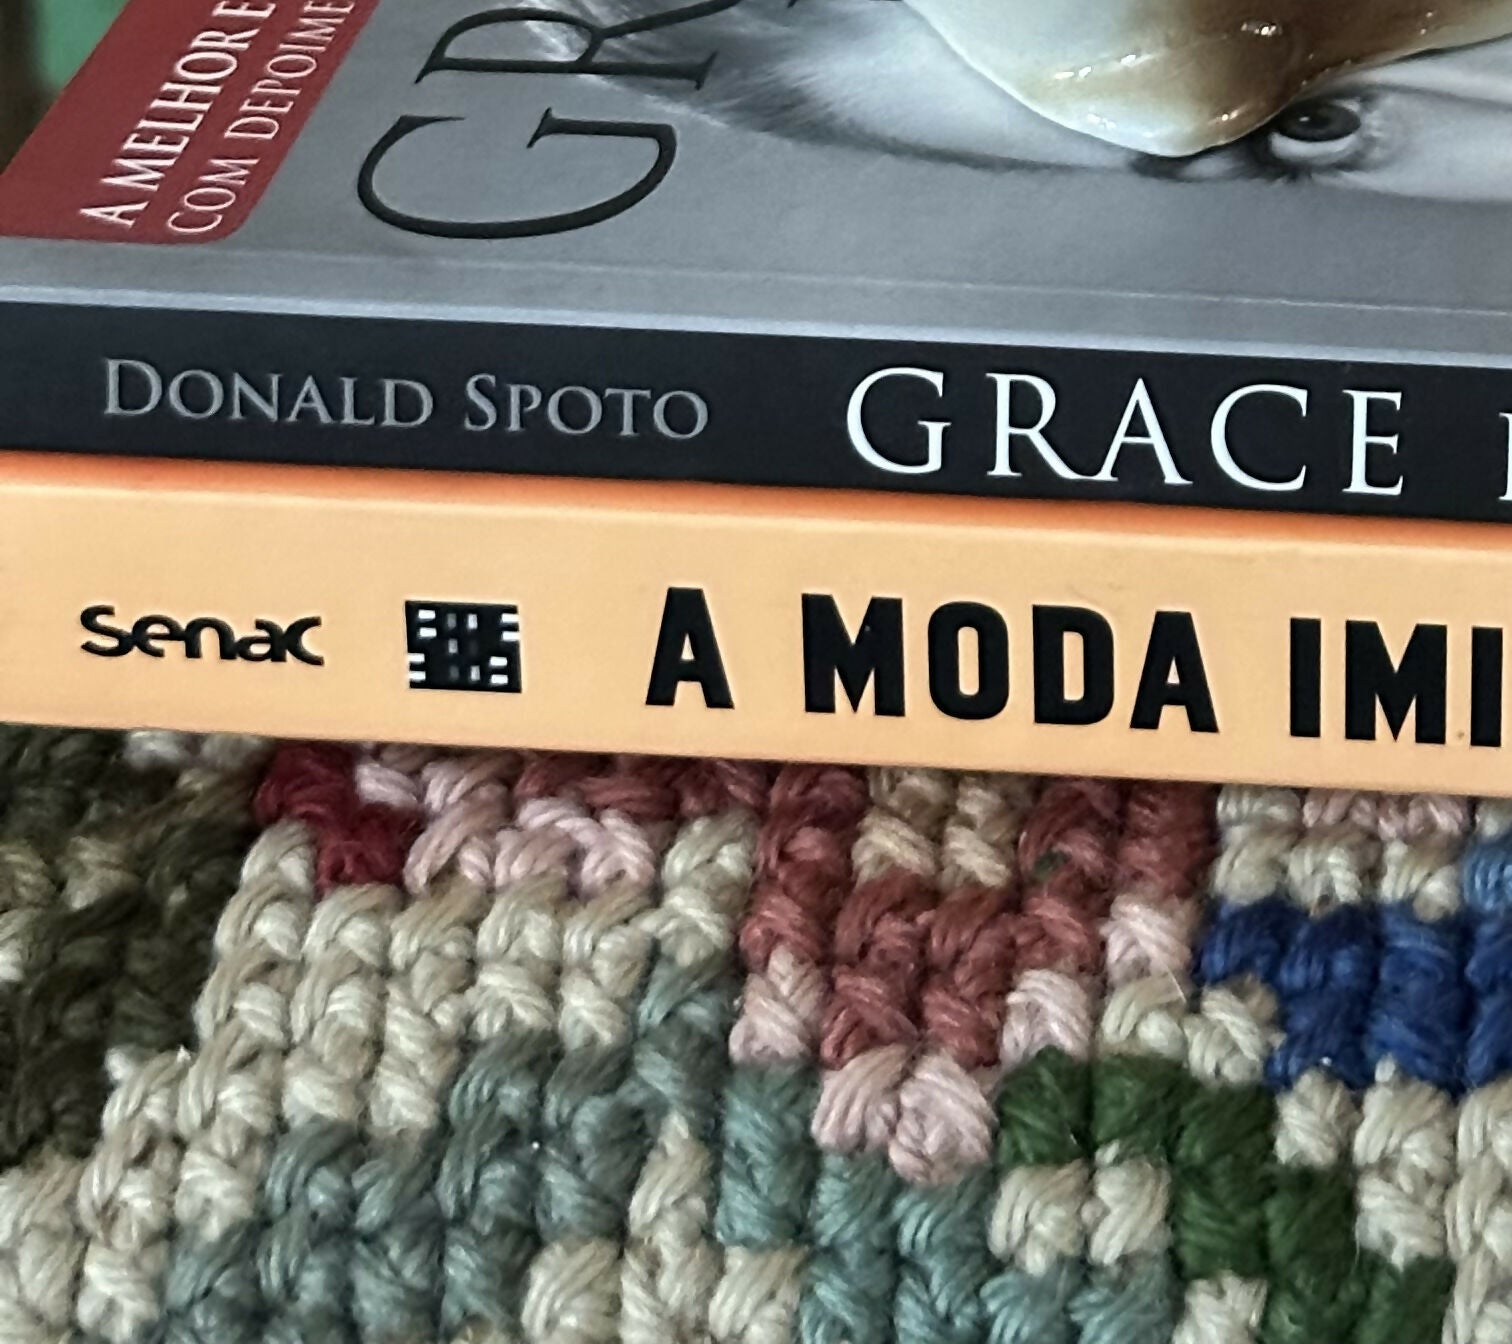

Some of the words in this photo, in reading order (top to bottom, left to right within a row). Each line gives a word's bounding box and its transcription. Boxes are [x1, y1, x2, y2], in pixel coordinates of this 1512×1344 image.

[211, 0, 277, 19] E
[100, 27, 261, 192] MELHOR
[79, 200, 150, 230] A
[166, 157, 261, 234] COM
[102, 356, 433, 430] DONALD
[463, 372, 711, 441] SPOTO
[845, 365, 1405, 497] GRACE
[645, 586, 736, 710] A
[801, 592, 1220, 734] MODA
